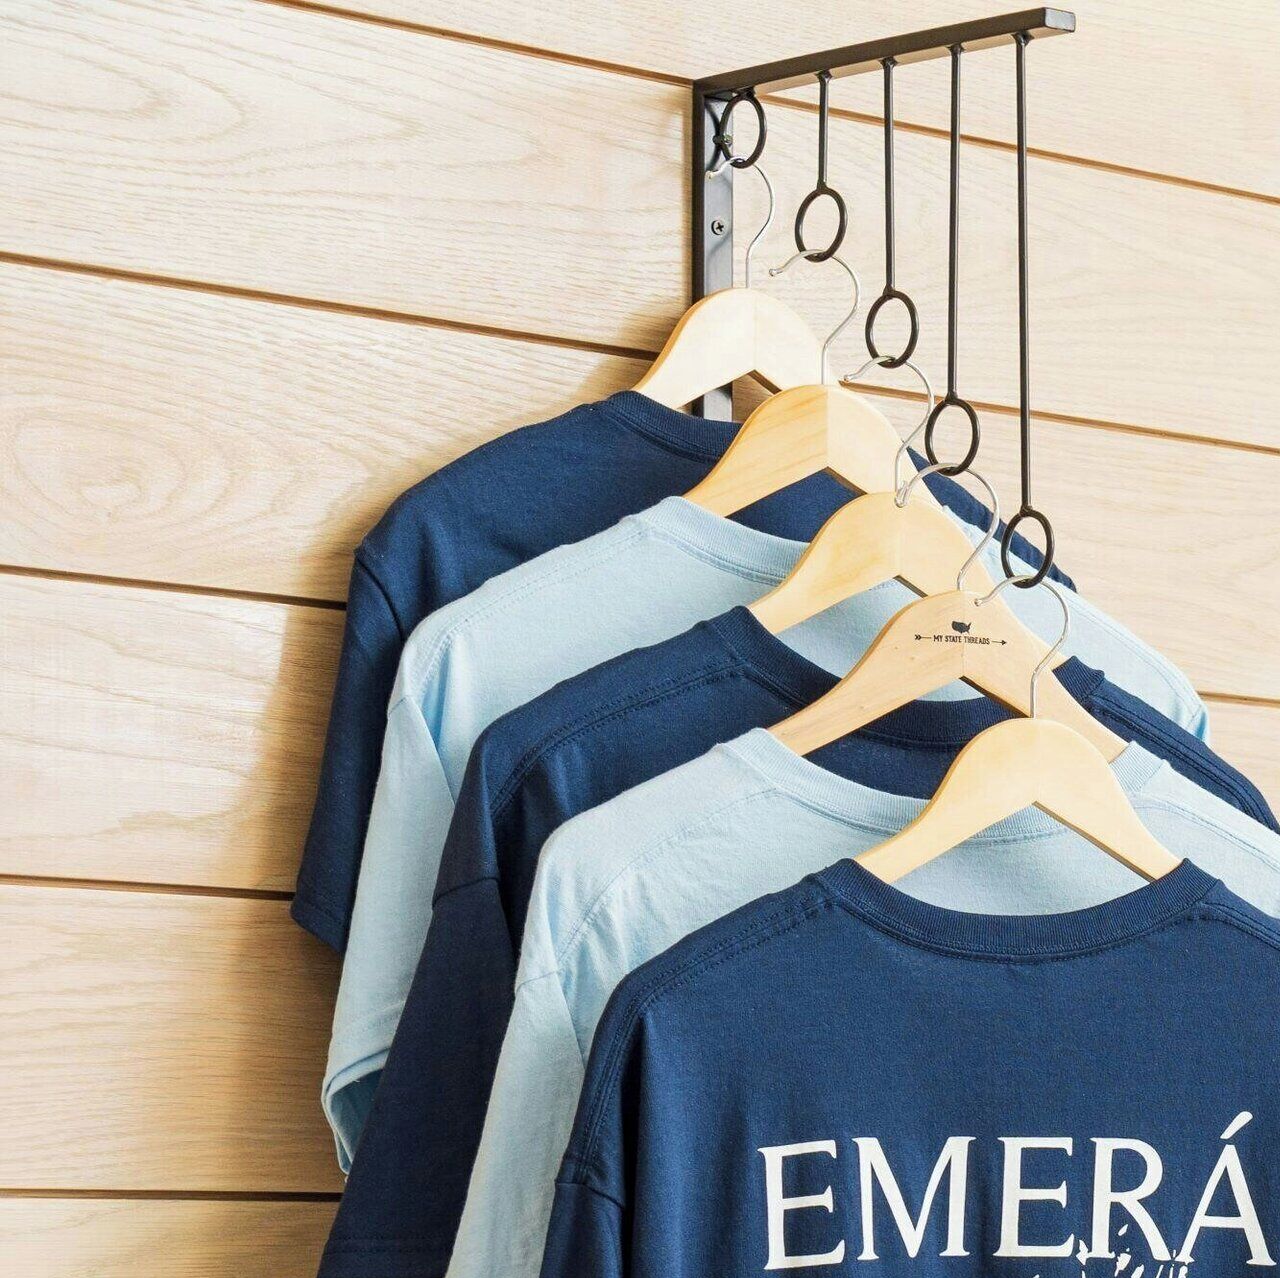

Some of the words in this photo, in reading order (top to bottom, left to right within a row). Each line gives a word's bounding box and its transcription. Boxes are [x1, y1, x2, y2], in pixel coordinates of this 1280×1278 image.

[933, 634, 944, 643] MY
[944, 635, 962, 644] STATE
[964, 635, 991, 645] THREADS
[757, 1110, 1277, 1271] EMERÁ
